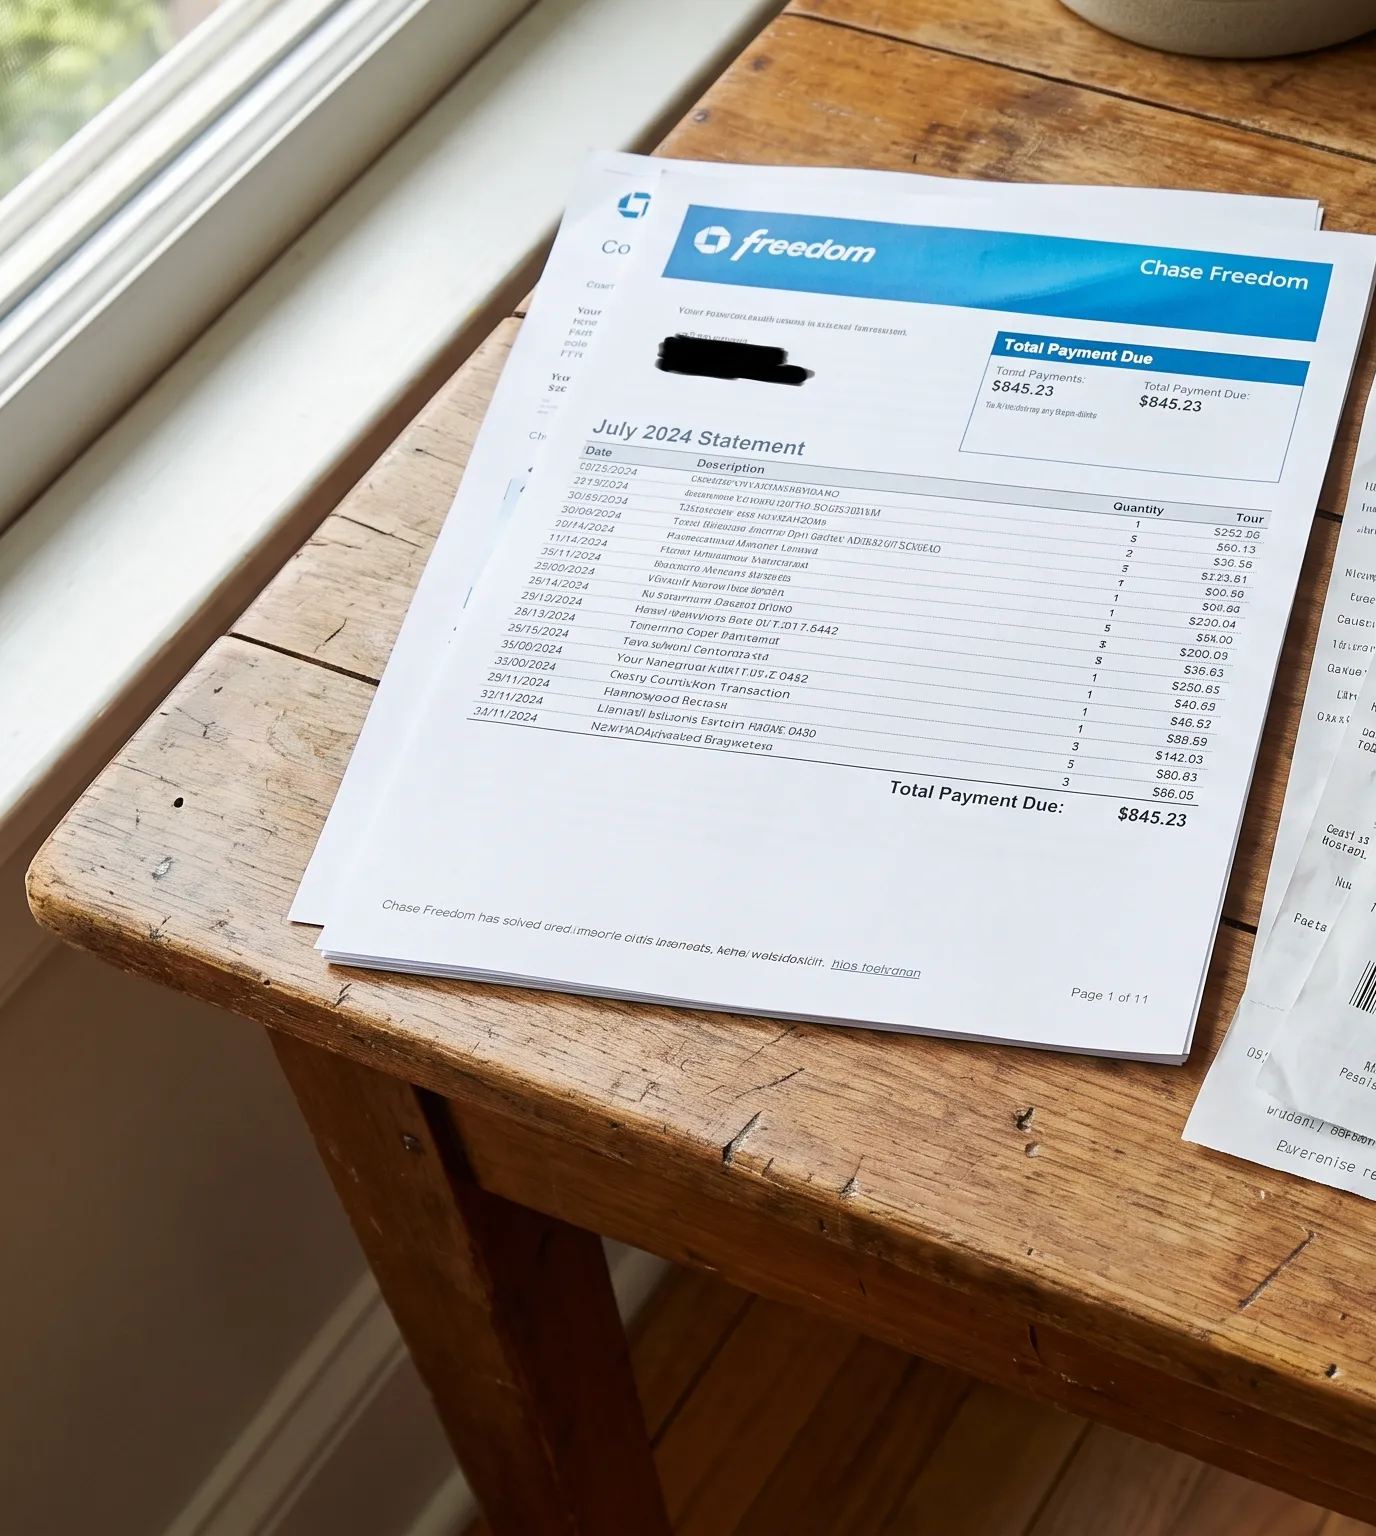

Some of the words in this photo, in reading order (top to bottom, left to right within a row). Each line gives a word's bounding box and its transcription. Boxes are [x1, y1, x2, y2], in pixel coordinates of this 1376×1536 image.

[731, 228, 876, 263] freedom
[1140, 259, 1203, 280] Chase
[1209, 265, 1309, 290] Freedom
[1003, 338, 1045, 356] Total
[1047, 342, 1118, 364] Payment
[1120, 349, 1154, 366] Due
[1028, 369, 1087, 384] Payments:
[991, 379, 1055, 398] $845.23
[1144, 381, 1170, 393] Total
[1172, 384, 1221, 398] Payment
[1224, 390, 1251, 401] Due:
[1139, 394, 1203, 413] $845.23
[592, 418, 638, 441] July
[641, 424, 693, 445] 2024
[697, 430, 806, 458] Statement
[585, 445, 613, 457] Date
[1113, 501, 1165, 517] Quantity
[1236, 512, 1265, 524] Tour
[720, 682, 791, 699] Transaction
[1071, 741, 1080, 751] 3
[1062, 777, 1070, 787] 3
[889, 779, 934, 800] Total
[938, 785, 1018, 811] Payment
[1021, 794, 1065, 814] Due:
[1117, 805, 1188, 828] $845.23
[381, 899, 421, 914] Chase
[423, 904, 476, 921] Freedom
[477, 911, 500, 925] has
[1070, 987, 1103, 1002] Page
[1108, 991, 1114, 1001] 1
[1118, 992, 1131, 1003] of
[1134, 994, 1149, 1004] 11
